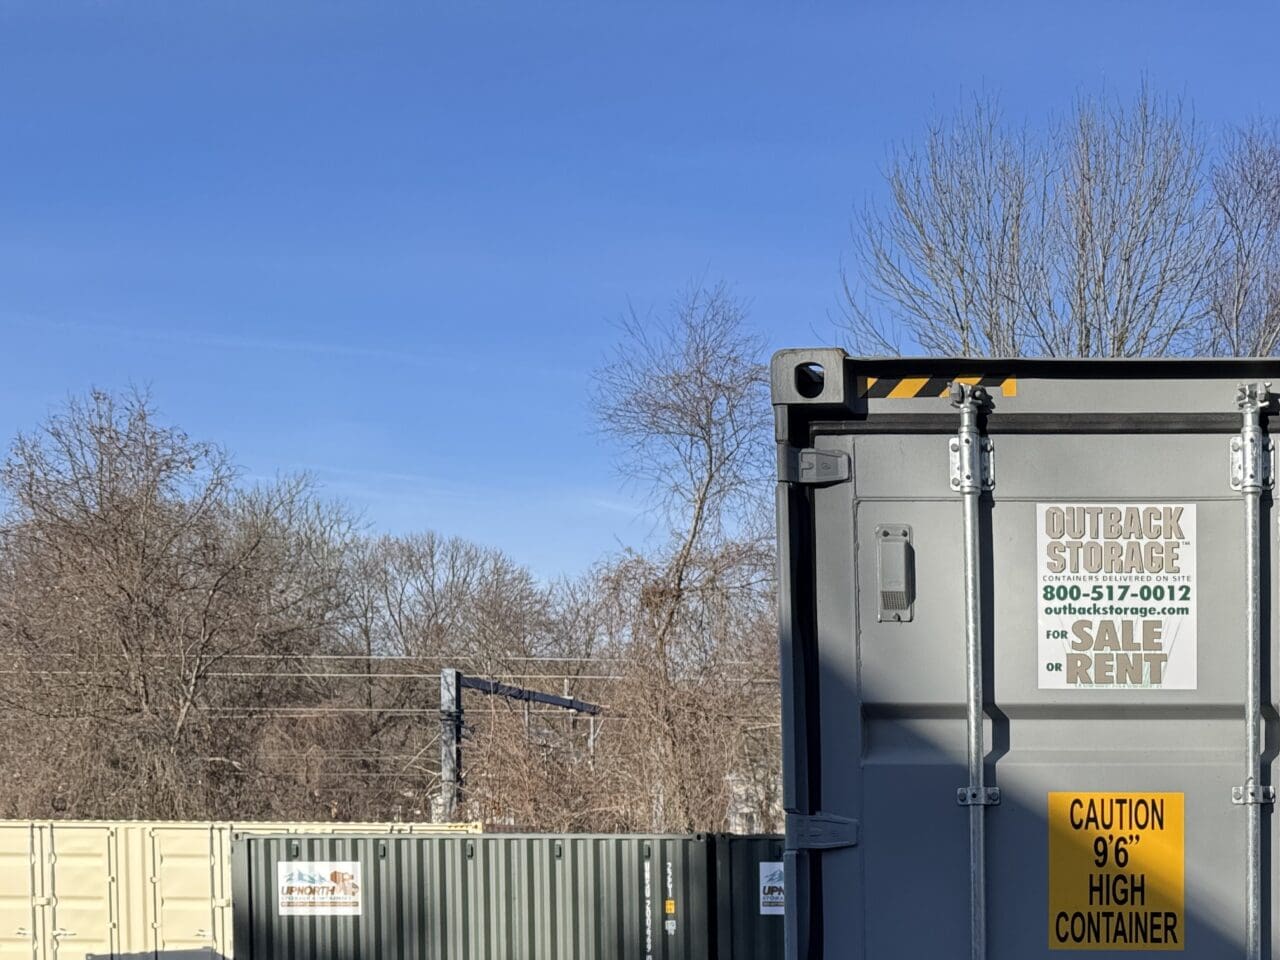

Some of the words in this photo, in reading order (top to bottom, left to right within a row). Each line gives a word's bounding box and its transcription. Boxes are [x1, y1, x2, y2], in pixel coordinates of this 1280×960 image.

[1045, 506, 1185, 540] OUTBACK
[1046, 541, 1181, 574] STORAGE
[1042, 585, 1191, 601] 800-517-0012
[1044, 603, 1190, 617] outbackstorage.com
[1046, 630, 1068, 640] FOR
[1071, 619, 1163, 651] SALE
[1046, 662, 1063, 672] OR
[1066, 653, 1168, 684] RENT
[1069, 798, 1165, 830] CAUTION
[1089, 874, 1145, 905] HIGH
[1055, 911, 1178, 944] CONTAINER
